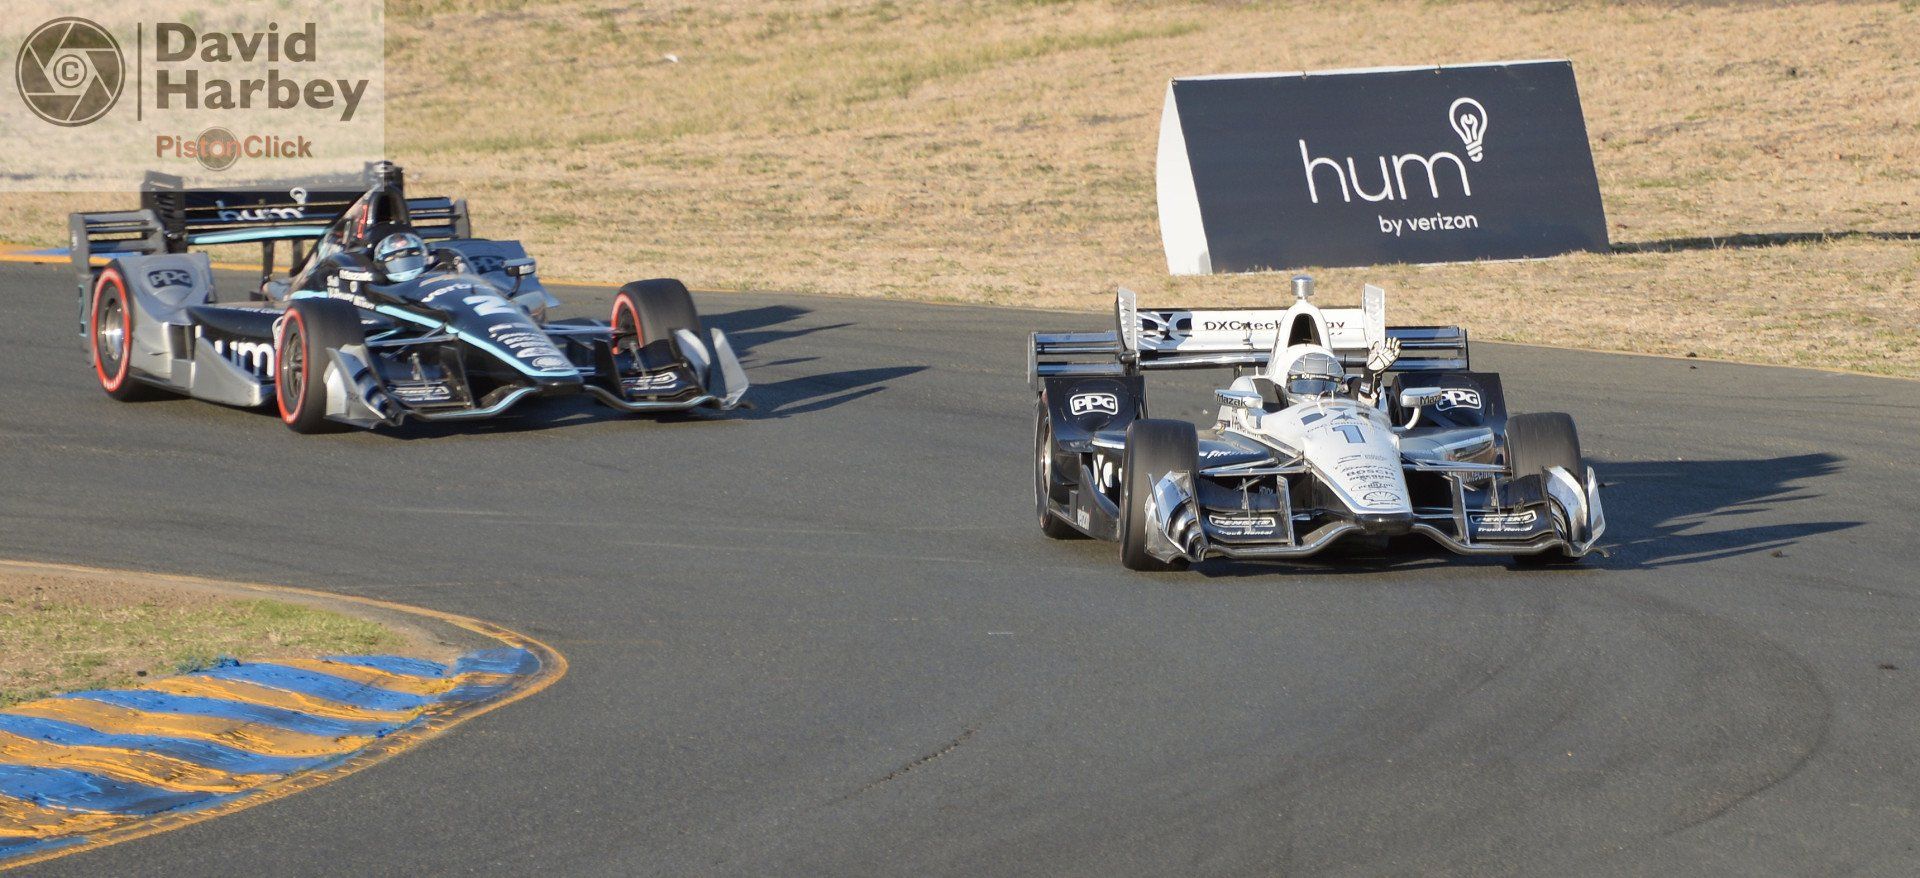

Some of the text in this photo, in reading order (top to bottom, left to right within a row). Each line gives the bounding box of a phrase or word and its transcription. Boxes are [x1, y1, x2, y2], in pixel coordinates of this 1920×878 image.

[1299, 139, 1472, 204] hum
[1378, 212, 1479, 237] by verizon
[150, 270, 192, 287] PPG
[1074, 395, 1117, 413] PPG
[1216, 393, 1248, 407] Mazak
[1331, 424, 1366, 444] 1
